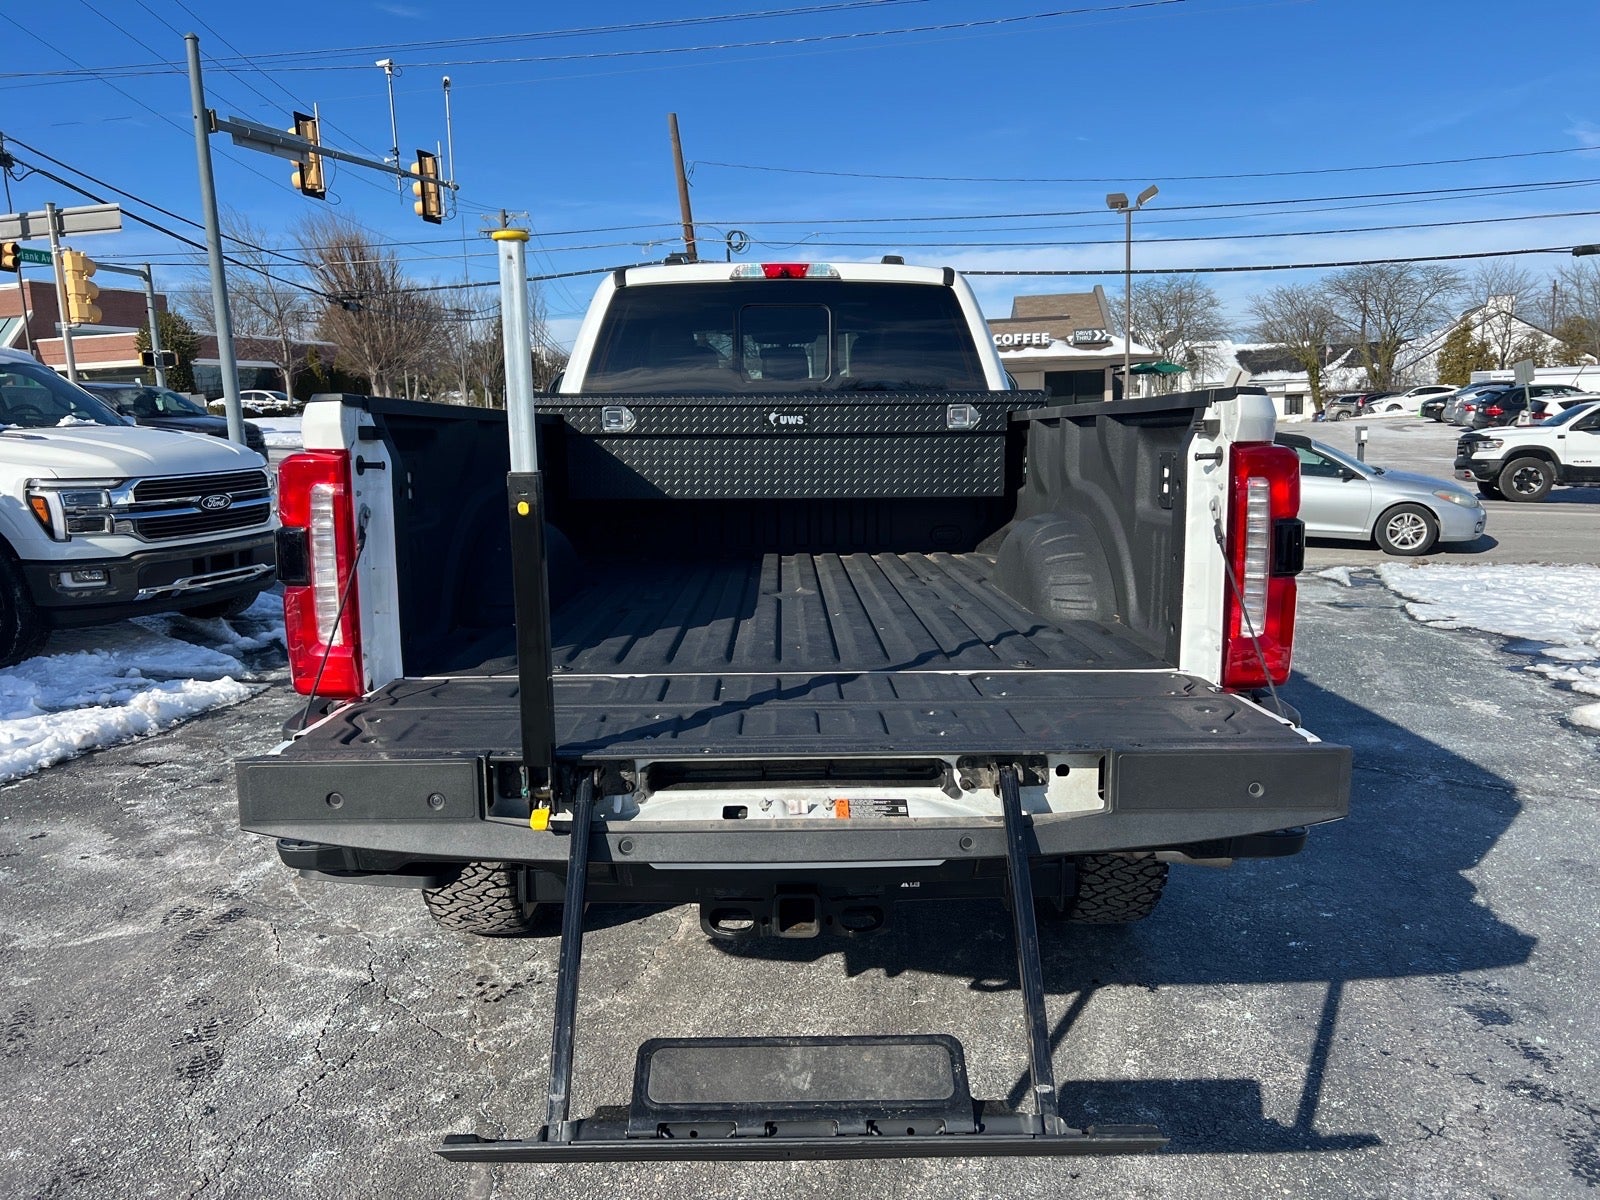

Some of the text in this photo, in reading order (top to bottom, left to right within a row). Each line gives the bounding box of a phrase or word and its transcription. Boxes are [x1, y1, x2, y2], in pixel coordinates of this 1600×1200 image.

[41, 254, 53, 263] Av
[993, 333, 1050, 345] COFFEE
[780, 415, 804, 425] UWS
[207, 496, 225, 508] Ford
